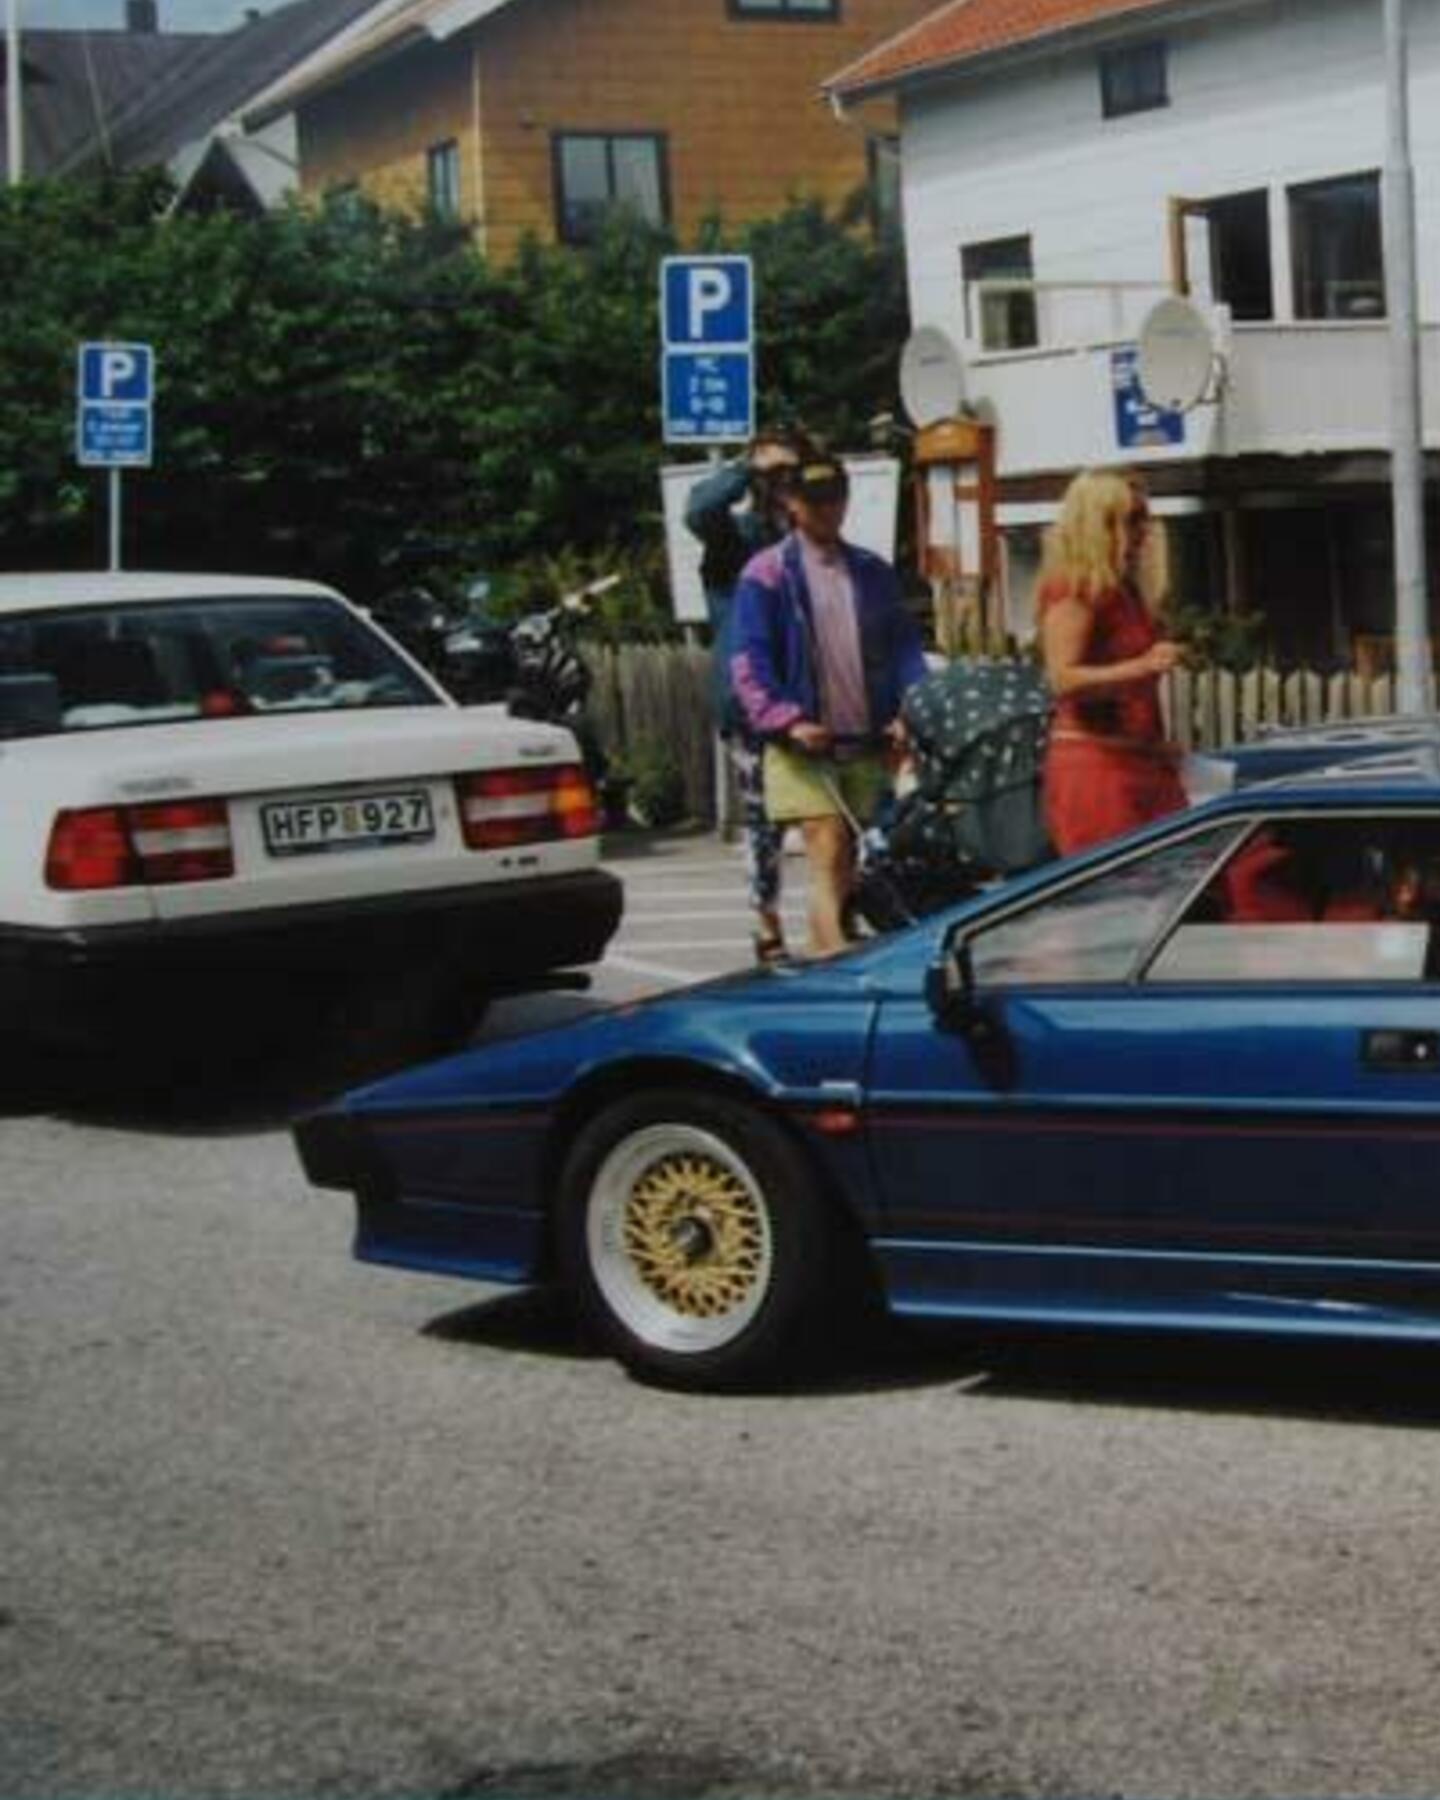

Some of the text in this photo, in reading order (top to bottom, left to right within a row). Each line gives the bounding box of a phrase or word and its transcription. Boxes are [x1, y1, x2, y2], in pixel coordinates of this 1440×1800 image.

[690, 269, 731, 339] P
[101, 352, 134, 397] P
[272, 799, 423, 840] HFP 927
